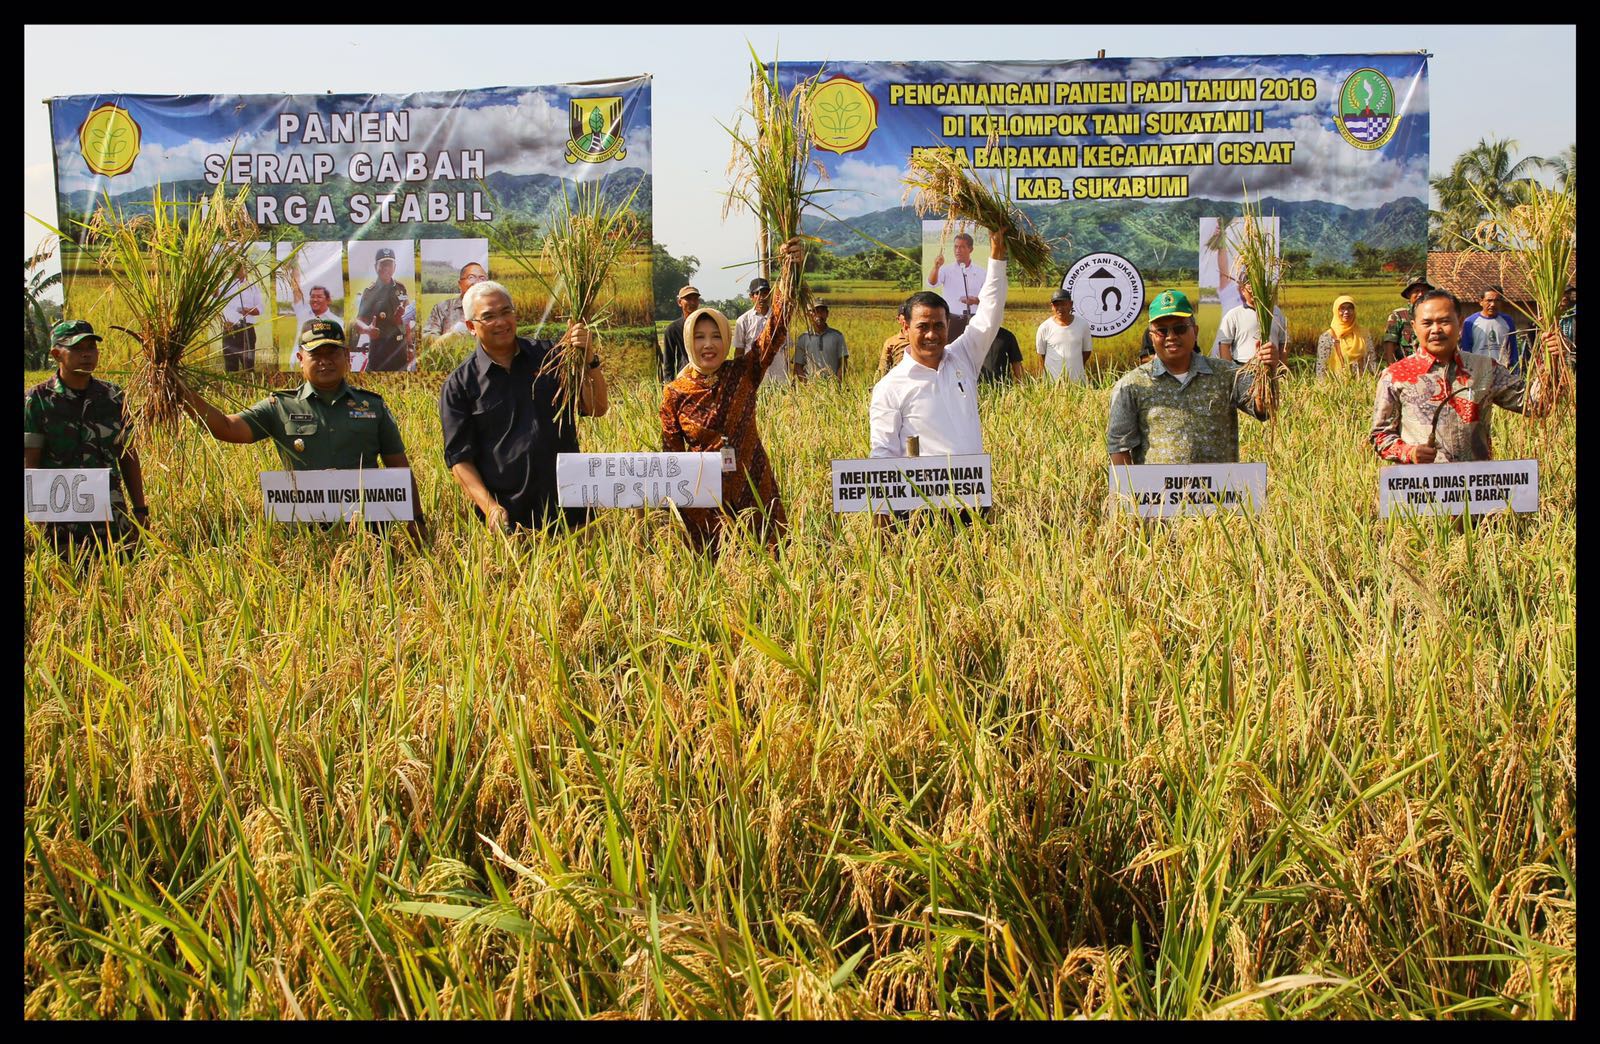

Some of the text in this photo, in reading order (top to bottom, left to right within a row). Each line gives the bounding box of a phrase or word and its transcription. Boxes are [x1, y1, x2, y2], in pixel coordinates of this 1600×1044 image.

[889, 78, 1316, 106] PENCANANGAN PANEN PADI TAHUN 2016
[279, 110, 409, 144] PANEN
[942, 109, 1264, 137] DI KELOMPOK TANI SUKATANI I
[204, 149, 485, 185] SERAP GABAH
[973, 145, 1078, 169] BABAKAN
[1082, 142, 1214, 168] KECAMATAN
[1218, 141, 1295, 165] CISAAT
[1016, 175, 1188, 200] KAB. SUKABUMI
[201, 191, 493, 225] RGA STABIL
[1066, 261, 1091, 296] LOMPOK
[1113, 260, 1139, 294] SUKATANI
[1090, 307, 1136, 332] Sukabumi
[588, 456, 681, 477] PENJAB
[906, 467, 983, 483] PERTANIAN
[26, 474, 95, 513] LOG
[839, 485, 907, 500] REPUBLIK
[1388, 473, 1529, 490] KEPALA DINAS PERTANIAN
[1475, 488, 1510, 501] BARAT
[267, 489, 324, 504] PANGDAM
